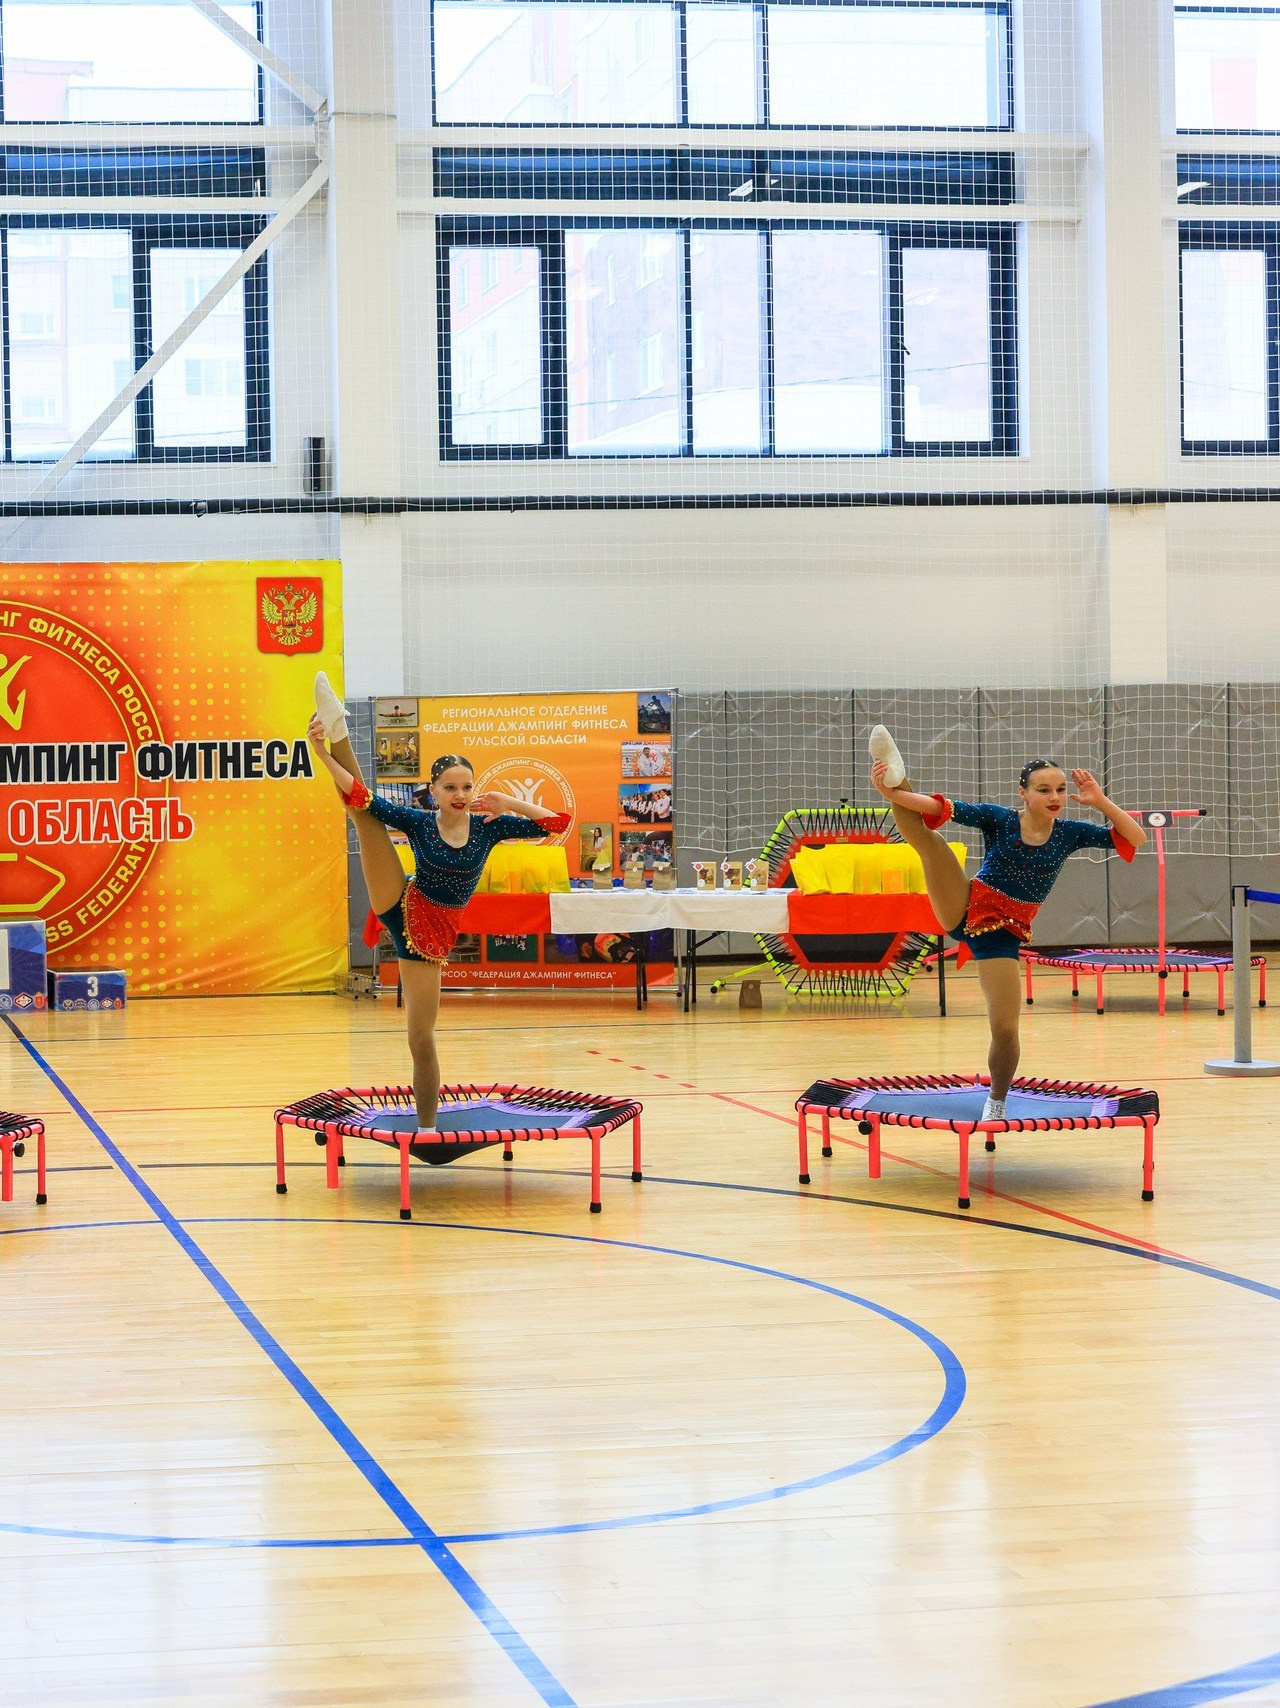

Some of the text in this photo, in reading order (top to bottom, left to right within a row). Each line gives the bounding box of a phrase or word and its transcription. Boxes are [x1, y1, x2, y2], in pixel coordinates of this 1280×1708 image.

[28, 617, 121, 685] ФИТНЕСА
[116, 684, 156, 745] РОСС
[442, 704, 608, 719] РЕГИОНАЛЬНОЕ ОТДЕЛЕНИЕ
[422, 718, 628, 734] ФЕДЕРАЦИИ ДЖАМПИНГ ФИТНЕСА
[462, 732, 587, 747] ТУЛЬСКОЙ ОБЛАСТИ
[136, 740, 314, 781] ФИТНЕСА
[7, 796, 195, 846] ОБЛАСТЬ
[75, 836, 149, 925] FEDERAT
[523, 970, 572, 980] ДЖАМПИНГ
[86, 976, 99, 998] 3
